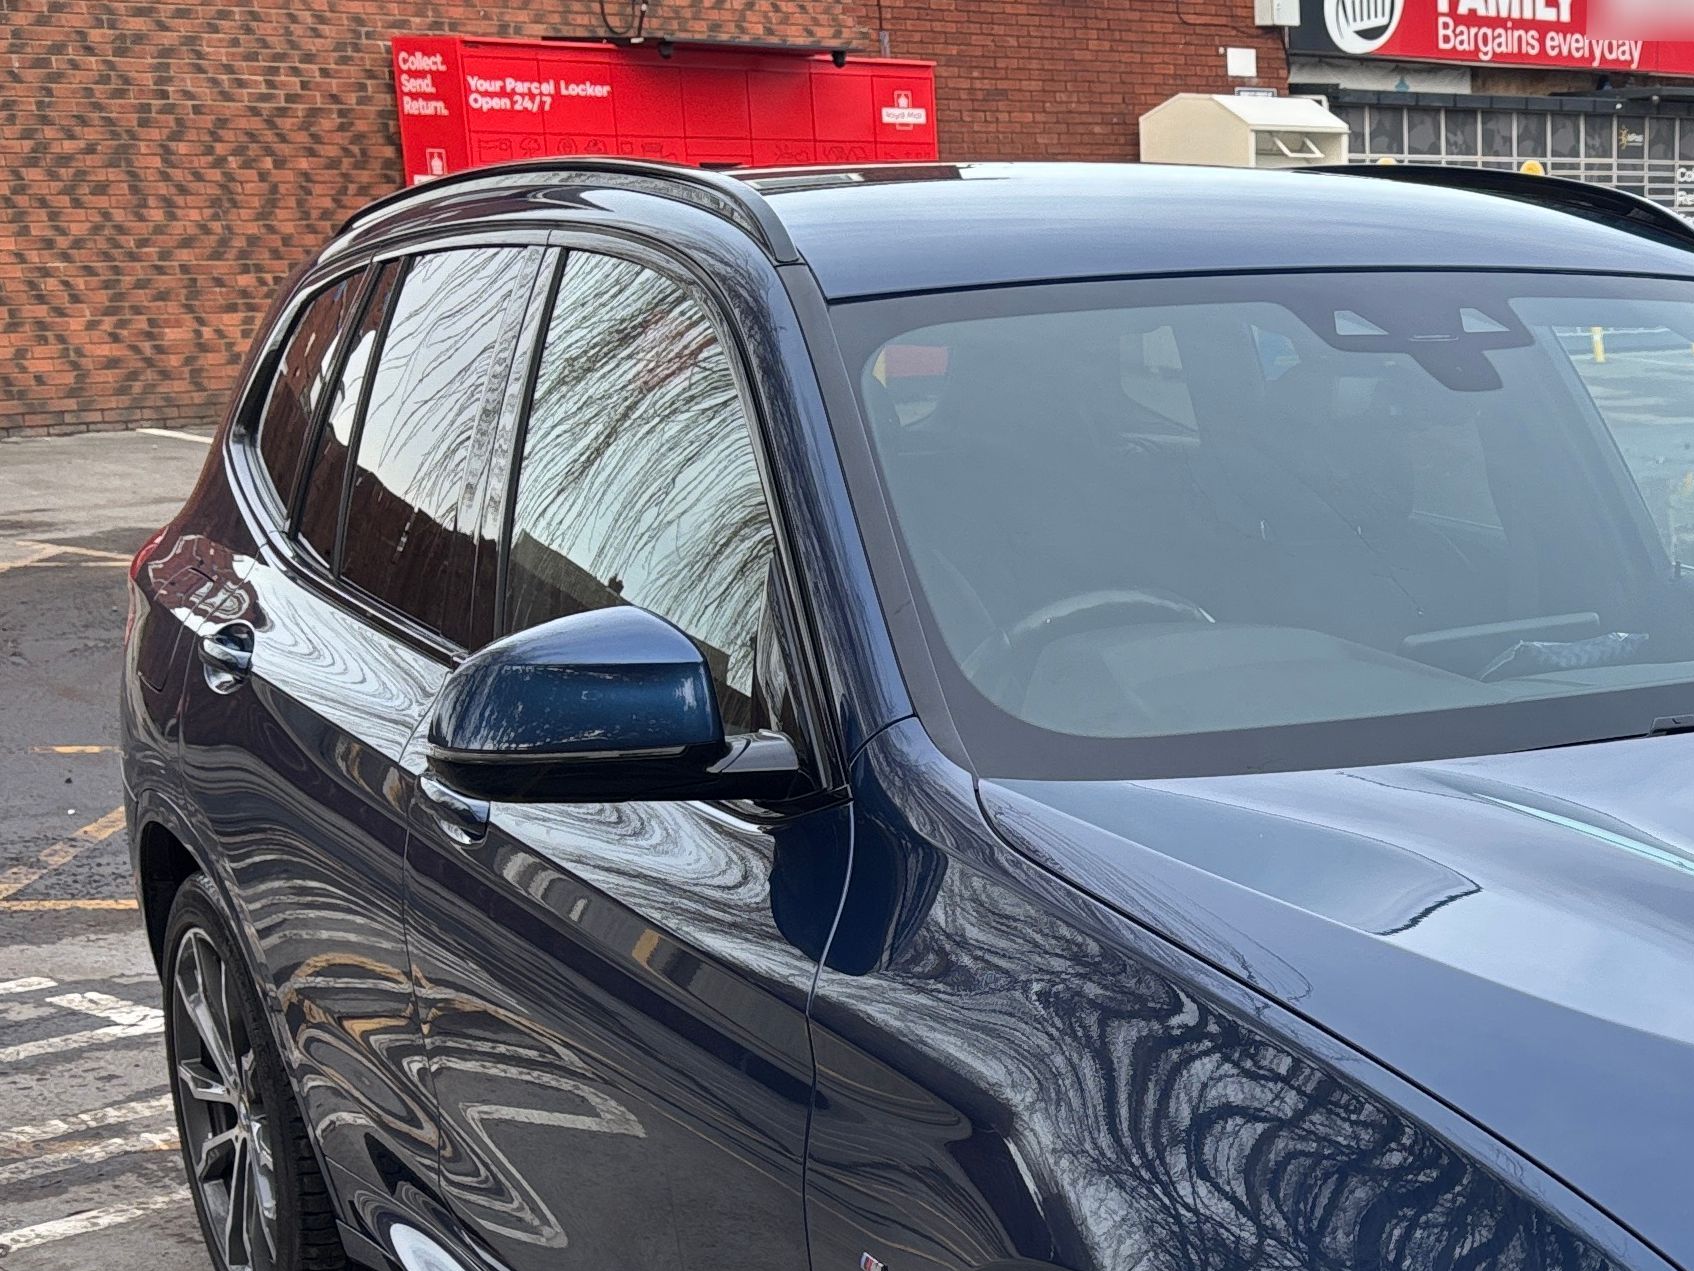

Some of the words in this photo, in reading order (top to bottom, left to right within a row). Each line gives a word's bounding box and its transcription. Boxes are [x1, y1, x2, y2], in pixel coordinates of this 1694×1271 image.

[1437, 16, 1540, 61] Bargains
[398, 51, 447, 71] Collect.
[400, 73, 436, 93] Send.
[467, 75, 504, 91] Your
[505, 77, 554, 95] Parcel
[560, 80, 612, 97] Locker
[402, 96, 449, 116] Return.
[469, 93, 511, 111] Open
[513, 95, 553, 112] 24/7
